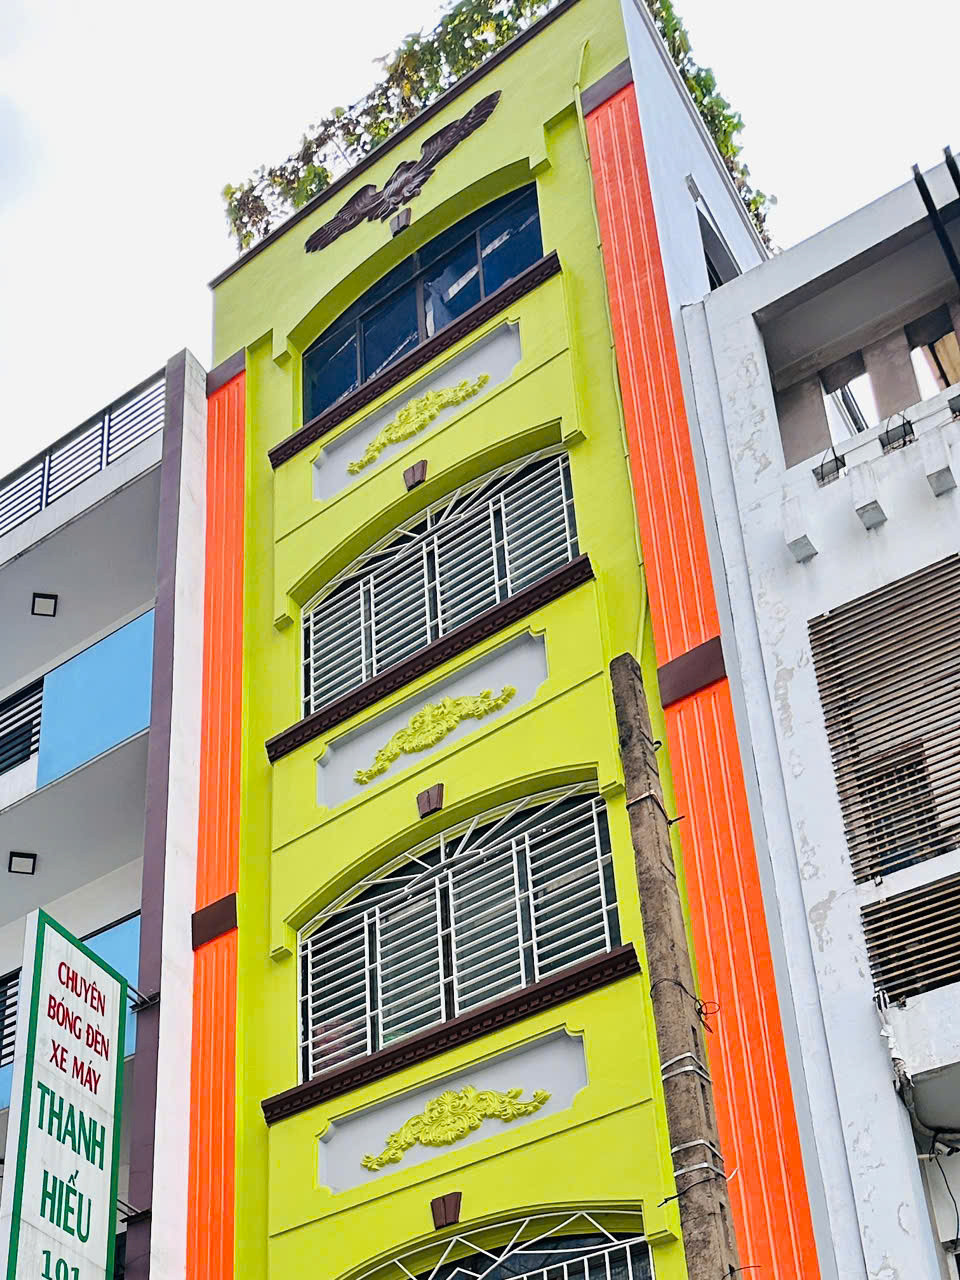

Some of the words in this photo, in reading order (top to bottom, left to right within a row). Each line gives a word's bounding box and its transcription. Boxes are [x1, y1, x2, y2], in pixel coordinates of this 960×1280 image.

[58, 961, 106, 1017] CHUYÊN
[47, 993, 82, 1040] BÓNG
[86, 1023, 109, 1061] ĐÈN
[49, 1039, 68, 1074] XE
[72, 1055, 101, 1095] MÁY
[37, 1080, 106, 1171] THANH
[40, 1169, 92, 1243] HIẾU
